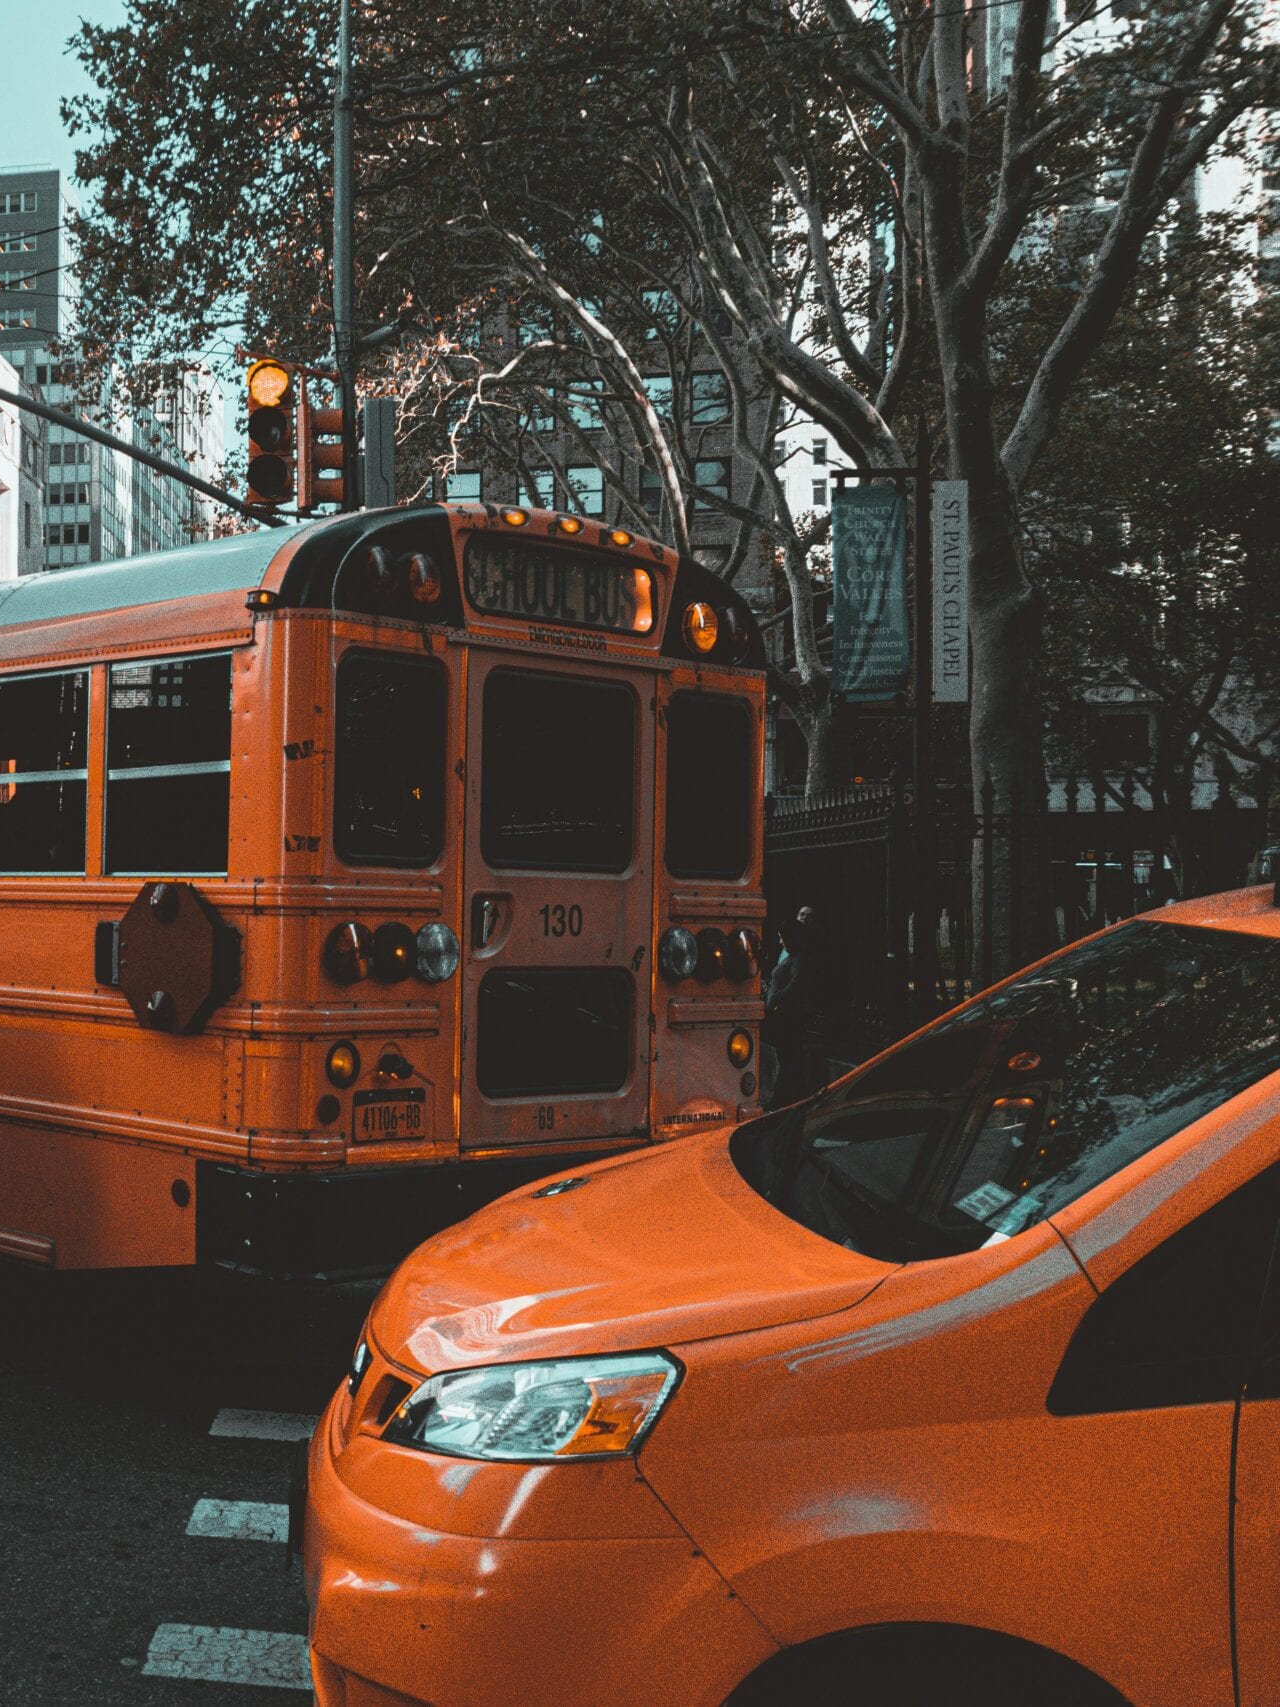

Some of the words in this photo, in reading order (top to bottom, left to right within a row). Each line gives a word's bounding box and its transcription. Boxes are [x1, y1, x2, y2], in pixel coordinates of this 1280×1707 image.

[584, 562, 636, 626] BUS
[942, 600, 960, 683] CHAPEL
[538, 903, 583, 938] 130
[663, 1112, 727, 1125] INTERNATIONAL
